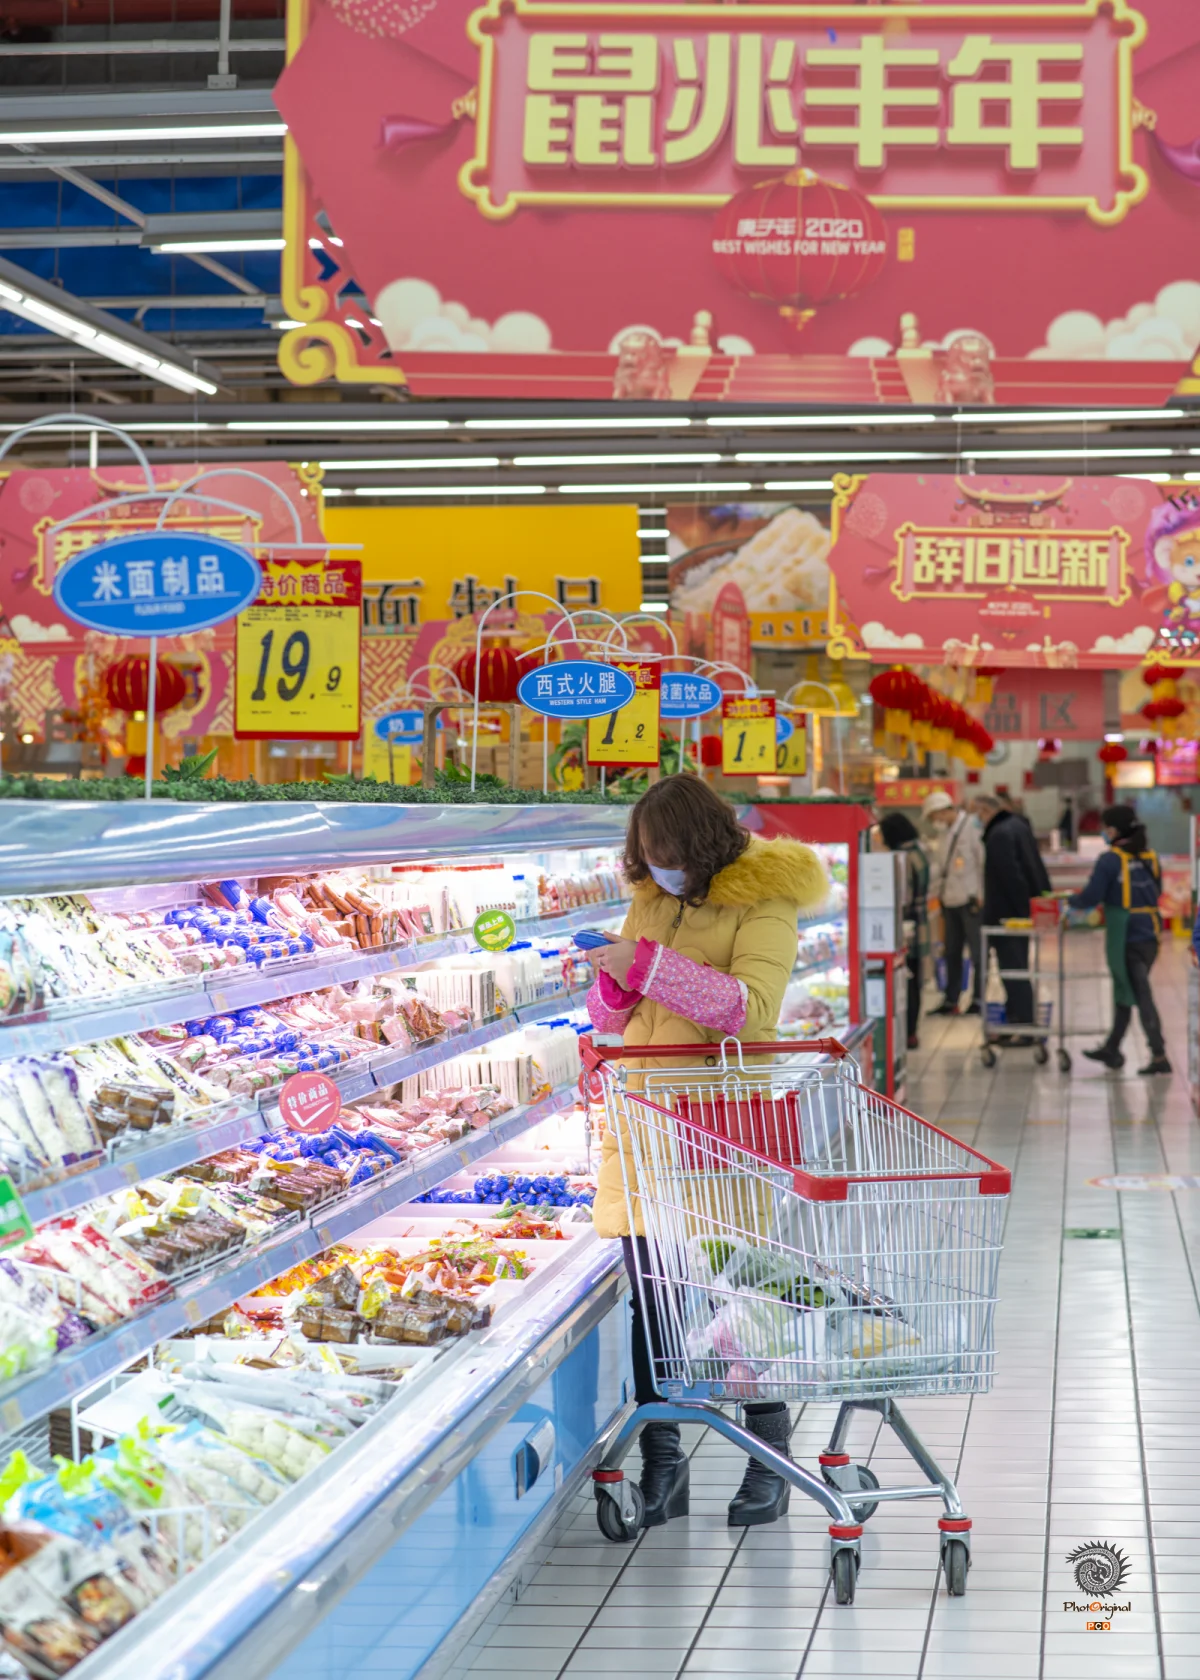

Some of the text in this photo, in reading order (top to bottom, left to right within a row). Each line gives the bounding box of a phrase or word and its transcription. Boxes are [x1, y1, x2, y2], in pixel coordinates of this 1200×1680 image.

[523, 32, 1083, 168] 鼠兆丰年
[805, 218, 863, 238] 2020
[712, 240, 741, 254] BEST
[744, 240, 791, 255] WISHES
[794, 240, 818, 255] FOR
[821, 241, 850, 255] NEW
[853, 240, 886, 254] YEAR
[92, 555, 225, 601] 米面制品
[912, 536, 1109, 586] 辞旧迎新
[535, 671, 617, 697] 西式火腿
